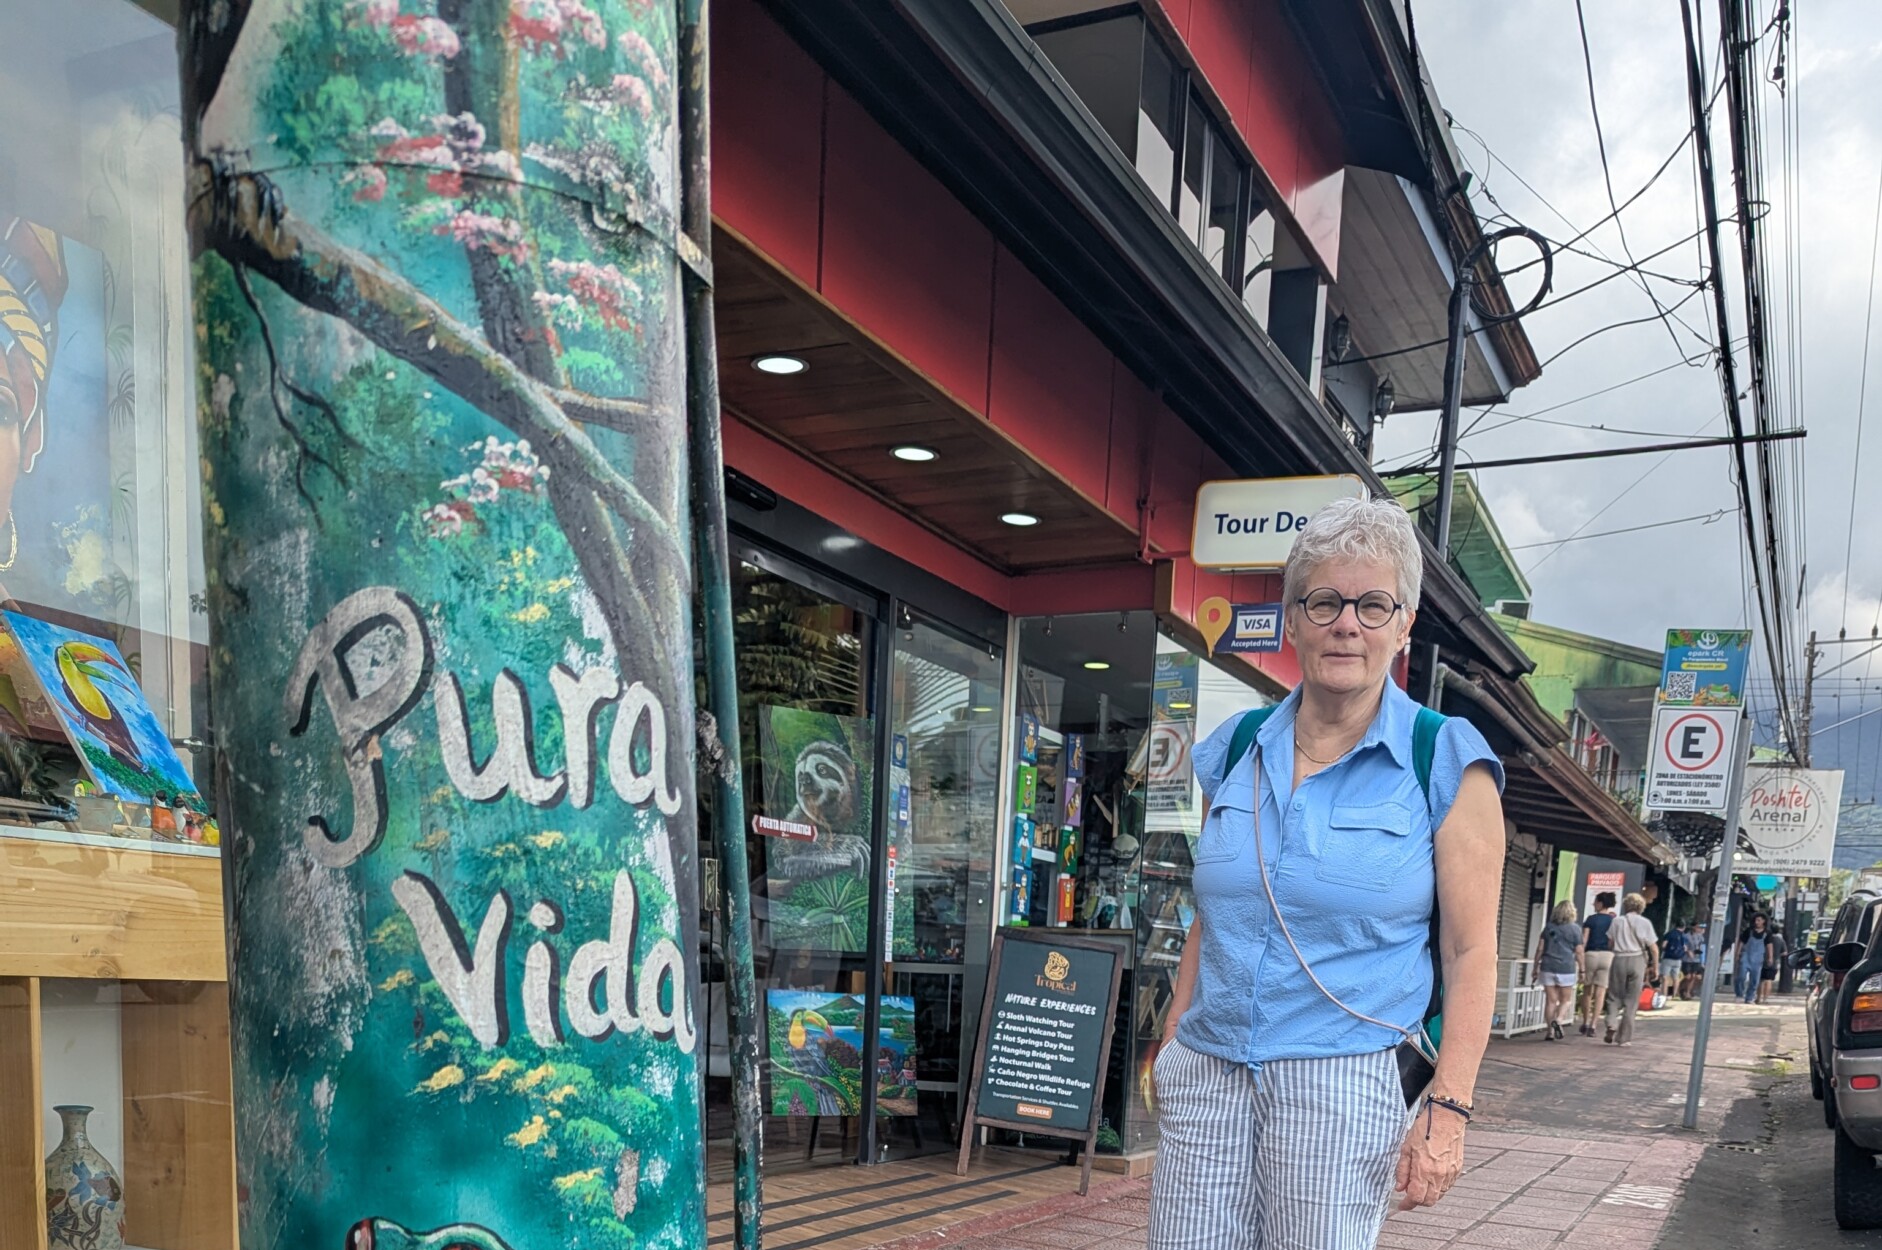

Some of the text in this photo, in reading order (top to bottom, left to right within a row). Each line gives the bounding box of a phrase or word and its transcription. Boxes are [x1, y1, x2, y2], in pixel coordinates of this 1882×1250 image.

[1214, 511, 1308, 534] Tour De
[1242, 618, 1271, 630] VISA
[1231, 639, 1278, 648] Accepted Here
[1687, 650, 1710, 658] epark
[284, 585, 681, 869] Pura
[1680, 725, 1707, 759] E
[1686, 789, 1707, 797] SÁBADO
[1749, 784, 1812, 809] Poshtel
[760, 815, 779, 830] PUERTA
[1749, 808, 1808, 823] Arenal
[1735, 857, 1771, 866] hatsapp:
[1772, 858, 1789, 866] (506)
[391, 869, 696, 1053] Vida
[1035, 974, 1077, 991] Tropical
[1004, 992, 1038, 1006] NATURE
[1040, 998, 1096, 1015] EXPERIENCES
[1006, 1012, 1075, 1029] Sloth Watching Tour
[1004, 1023, 1073, 1040] Arenal Volcano Tour
[1002, 1034, 1075, 1052] Hot Springs Day Pass
[1000, 1045, 1076, 1063] Hanging Bridges Tour
[998, 1056, 1052, 1071] Nocturnal Walk
[995, 1078, 1028, 1090] Chocolate
[1035, 1084, 1057, 1094] Coffee
[1057, 1087, 1073, 1096] Tour
[997, 1067, 1091, 1090] Caño Negro Wildlife Refuge
[992, 1091, 1022, 1100] Transportation
[1021, 1095, 1038, 1103] Services
[1019, 1105, 1050, 1116] BOOK HERE
